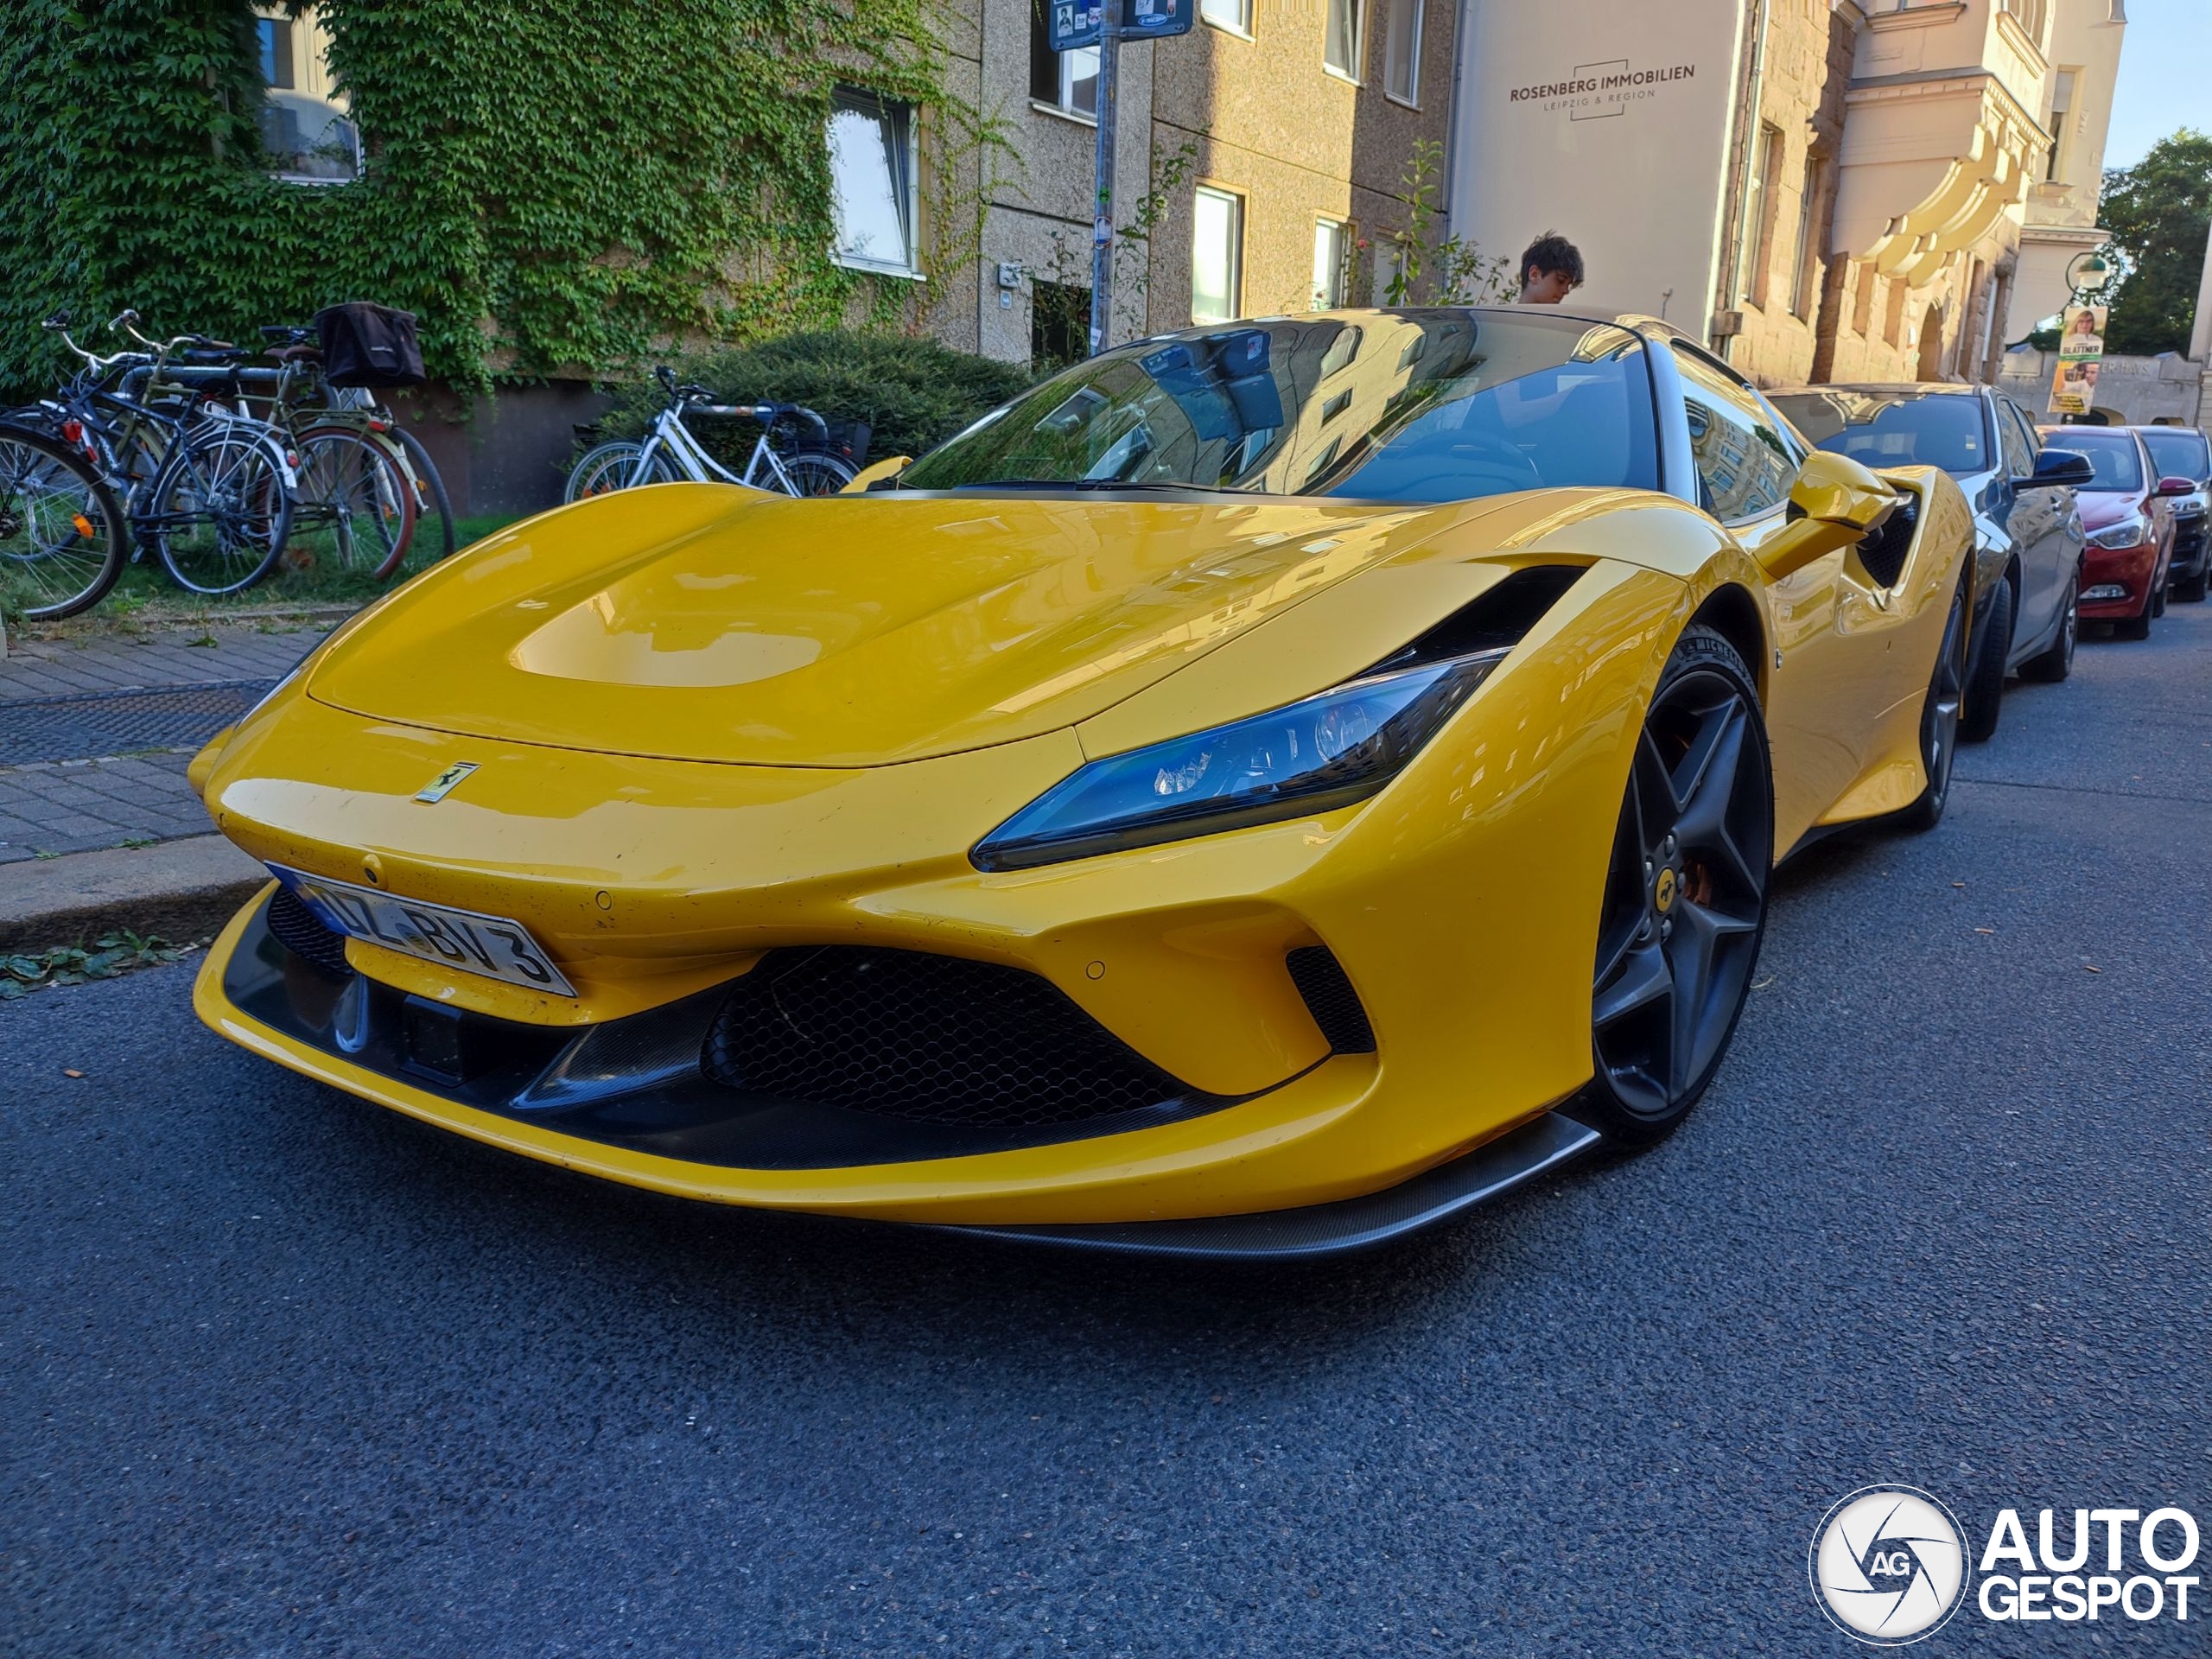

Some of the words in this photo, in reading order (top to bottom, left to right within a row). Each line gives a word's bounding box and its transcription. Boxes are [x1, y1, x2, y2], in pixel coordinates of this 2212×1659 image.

[1510, 79, 1597, 102] ROSENBERG
[1600, 65, 1694, 89] IMMOBILIEN
[1544, 98, 1590, 111] LEIPZIG
[1595, 96, 1602, 105] &
[1608, 90, 1656, 102] REGION
[2063, 346, 2100, 354] BLATTNER
[1695, 638, 1748, 677] MICHELIN
[399, 907, 499, 971] BV
[488, 927, 551, 983] 3
